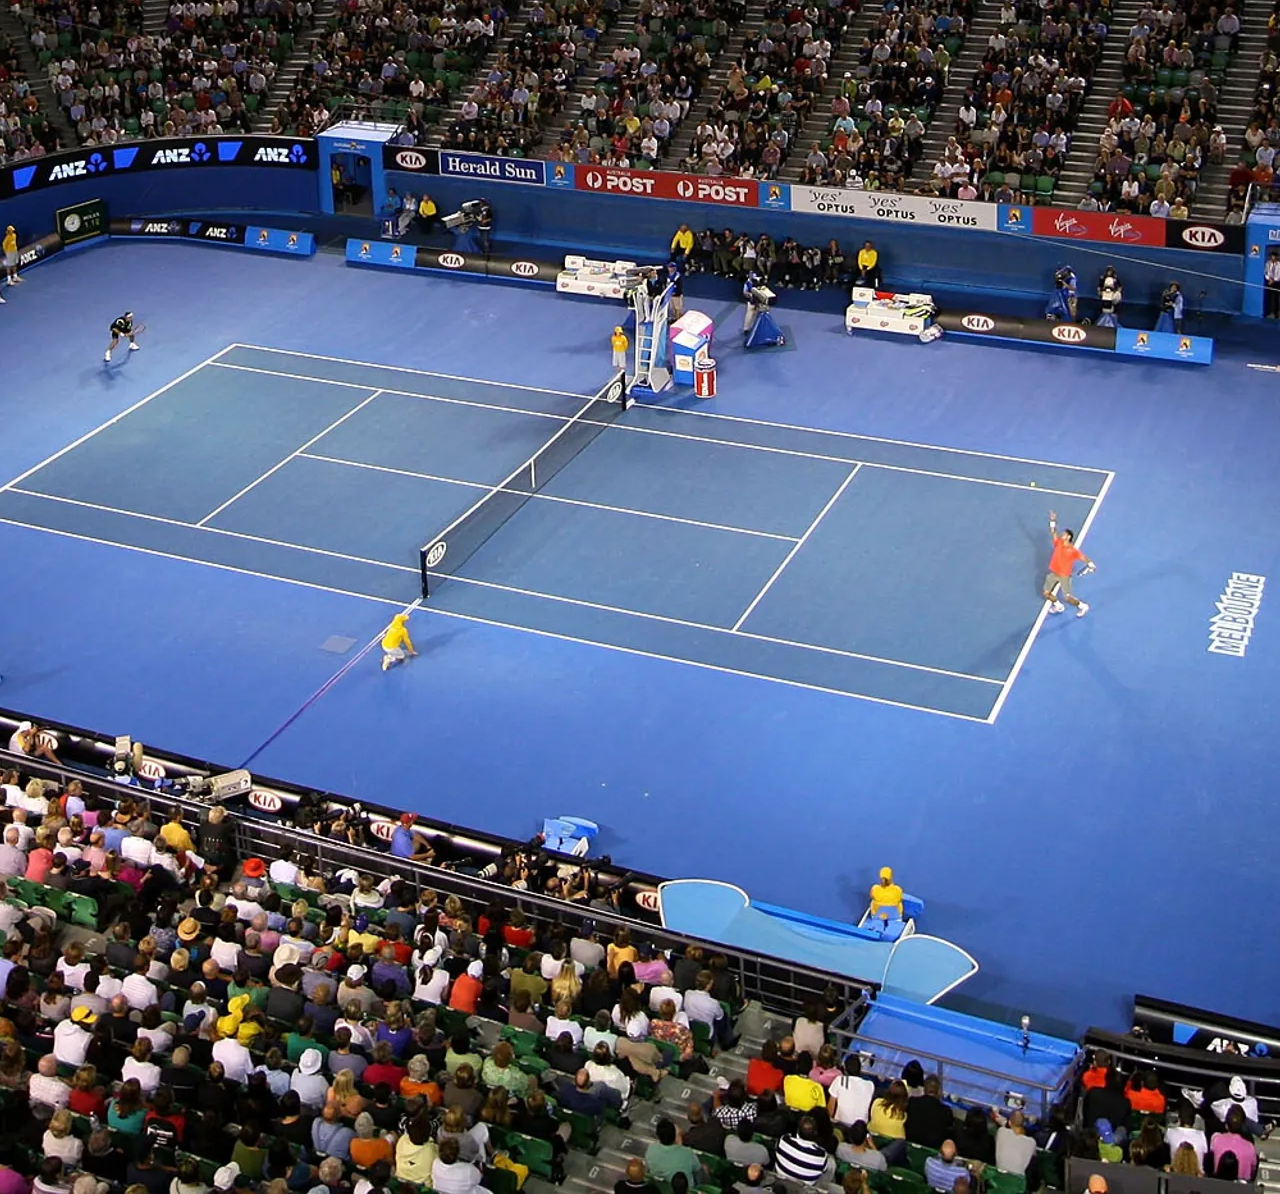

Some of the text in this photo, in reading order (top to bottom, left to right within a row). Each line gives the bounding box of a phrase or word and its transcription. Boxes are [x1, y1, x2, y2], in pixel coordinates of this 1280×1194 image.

[151, 147, 191, 164] ANZ
[254, 147, 290, 162] ANZ
[399, 153, 423, 167] KIA
[48, 160, 87, 182] ANZ
[447, 158, 538, 180] Herald Sun
[606, 174, 655, 194] POST
[698, 183, 749, 203] POST
[817, 201, 855, 215] OPTUS
[876, 207, 916, 220] OPTUS
[937, 212, 978, 226] OPTUS
[144, 222, 169, 233] ANZ
[206, 226, 227, 238] ANZ
[1187, 229, 1220, 244] KIA
[440, 255, 462, 266] KIA
[514, 263, 536, 274] KIA
[966, 316, 990, 329] KIA
[1055, 327, 1082, 340] KIA
[1208, 571, 1266, 657] MELBOURNE
[138, 762, 161, 778] KIA
[253, 793, 277, 809] KIA
